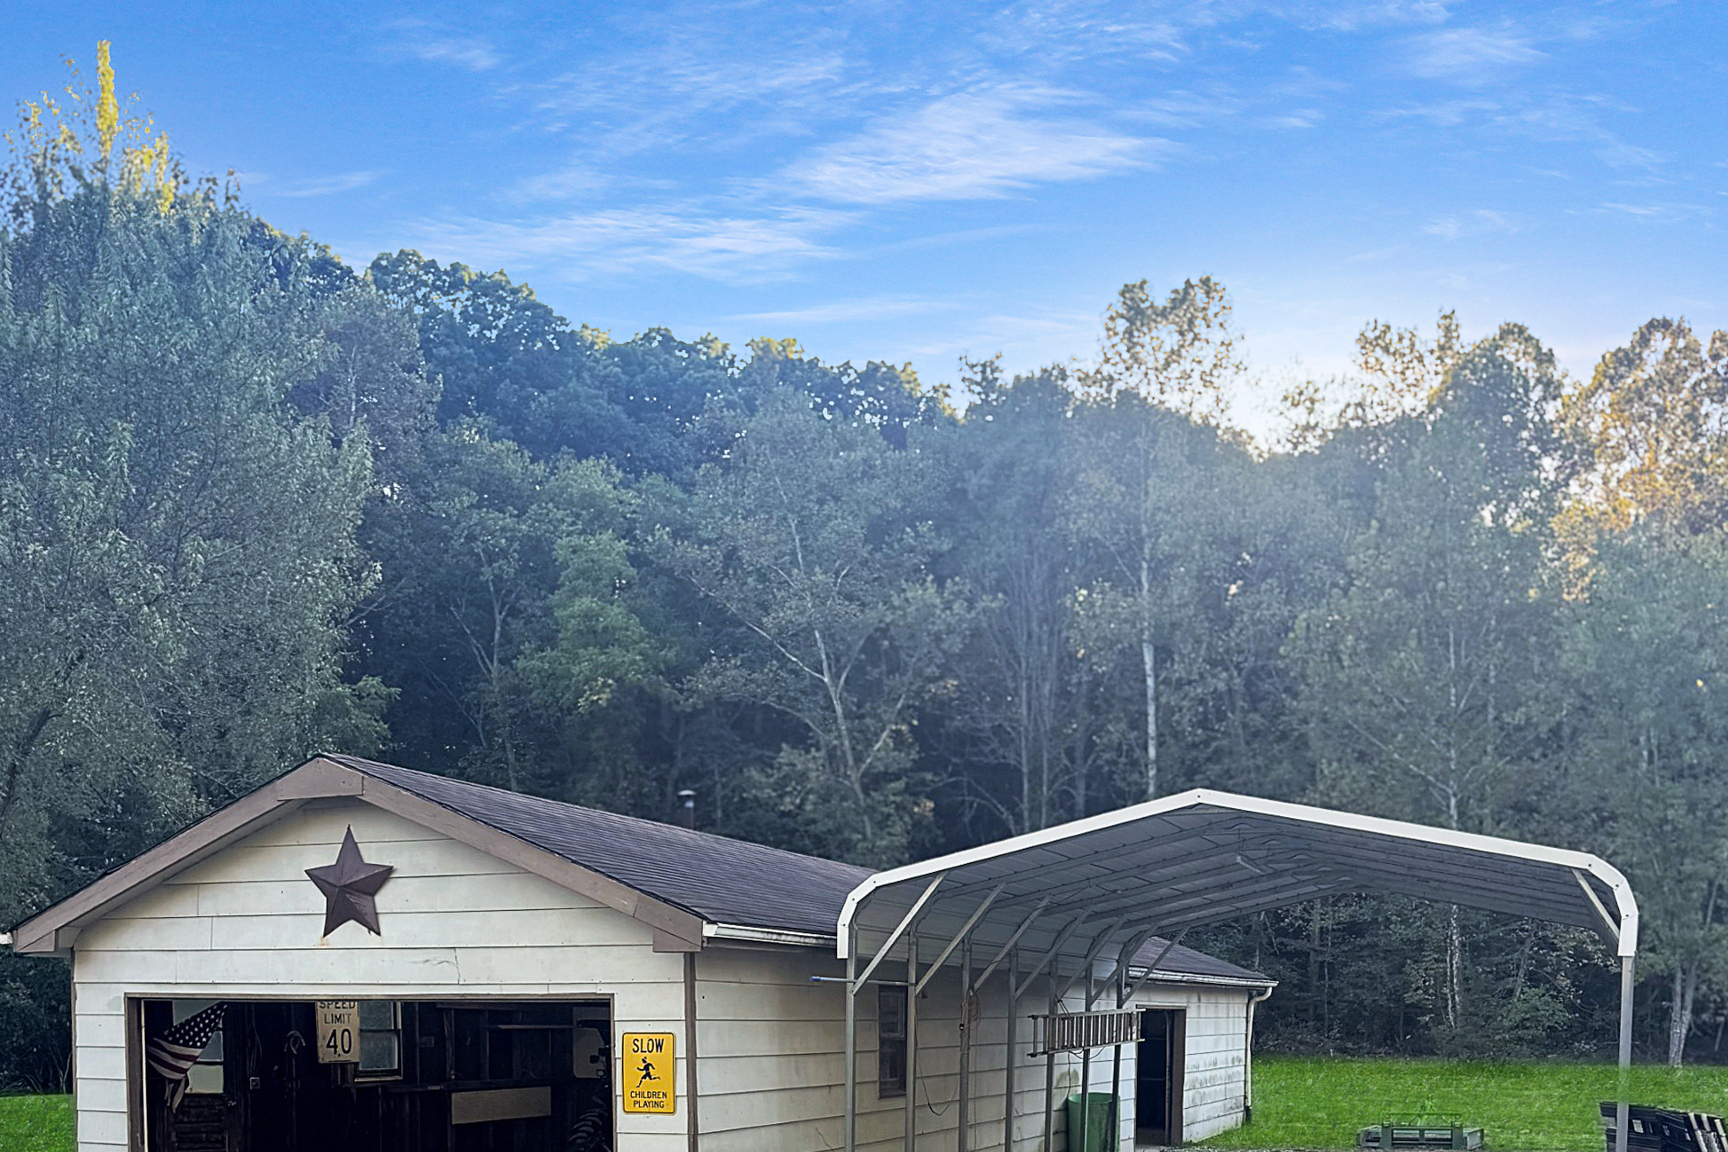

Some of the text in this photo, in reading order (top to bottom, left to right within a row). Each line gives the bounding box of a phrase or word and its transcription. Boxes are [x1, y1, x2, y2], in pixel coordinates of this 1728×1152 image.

[324, 1013, 352, 1024] LIMIT
[326, 1028, 352, 1055] 40
[632, 1038, 665, 1053] SLOW
[630, 1090, 668, 1099] CHILDREN
[633, 1100, 665, 1109] PLAYING
